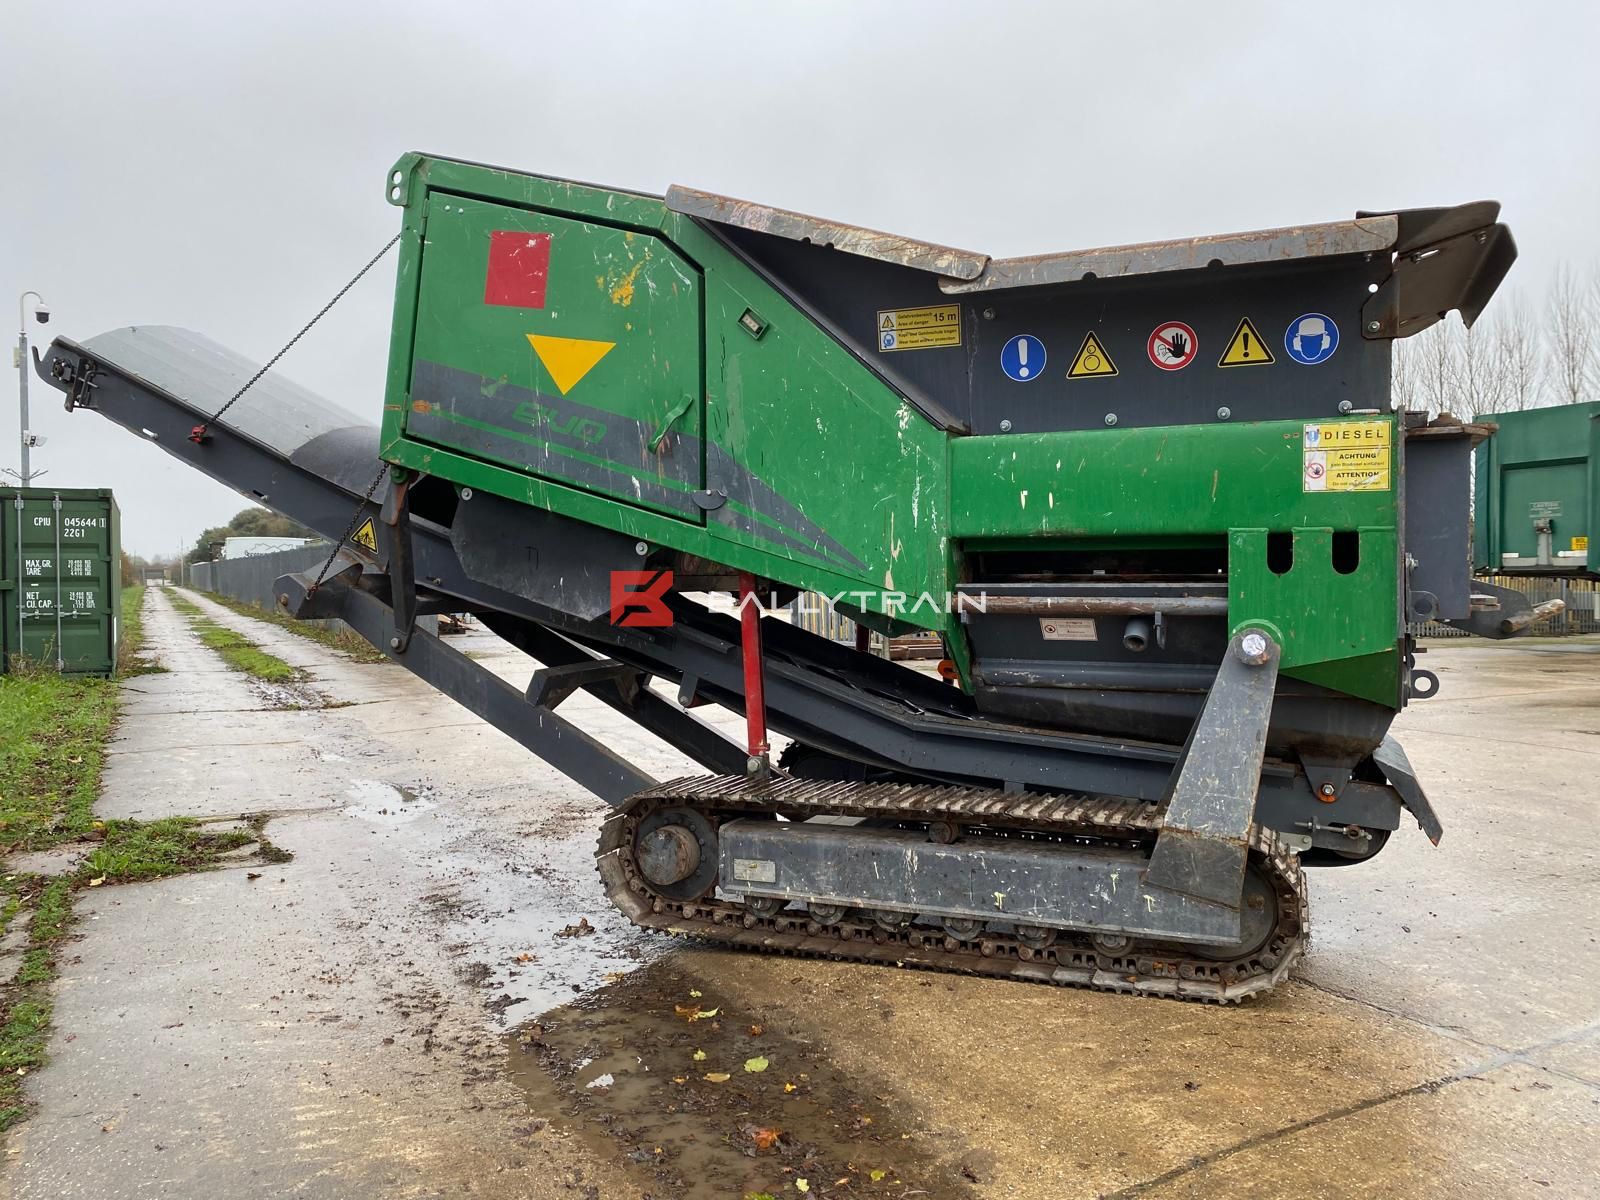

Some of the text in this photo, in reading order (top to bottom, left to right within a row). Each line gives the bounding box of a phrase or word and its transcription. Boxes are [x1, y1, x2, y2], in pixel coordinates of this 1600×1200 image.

[934, 313, 957, 321] 15 m
[1324, 429, 1384, 440] DIESEL
[33, 517, 51, 526] CPIU
[64, 517, 97, 527] 045644
[64, 528, 85, 537] 22G1
[26, 567, 42, 575] TARE
[26, 592, 39, 600] NET
